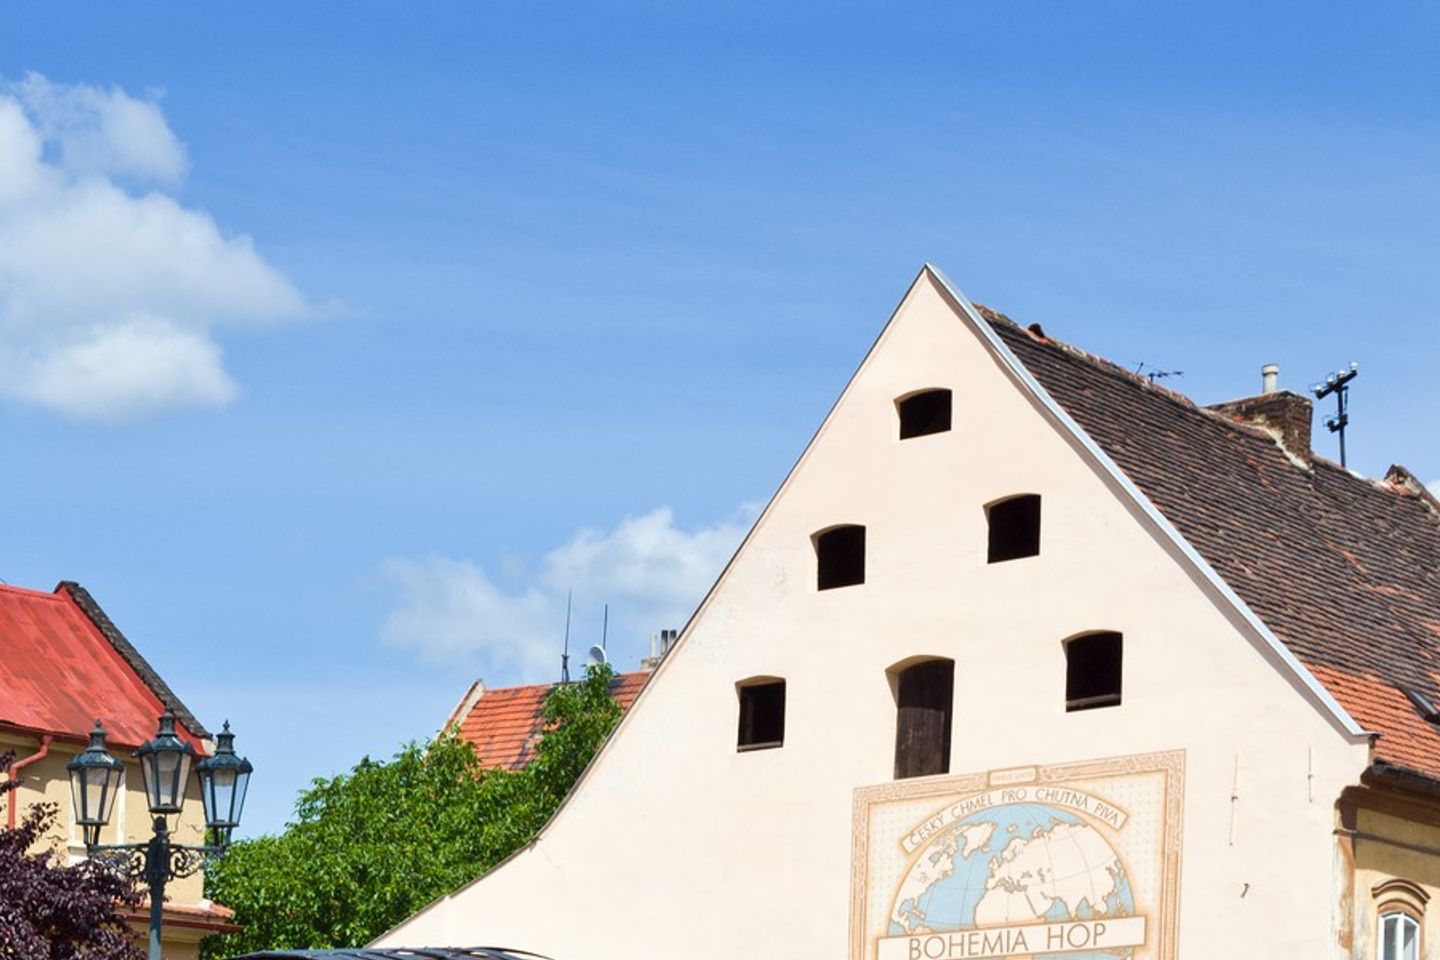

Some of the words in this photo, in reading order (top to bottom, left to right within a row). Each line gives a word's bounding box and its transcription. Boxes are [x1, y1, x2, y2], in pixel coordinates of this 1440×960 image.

[1001, 788, 1027, 803] PRO
[1094, 802, 1120, 826] PIVA
[909, 929, 1029, 960] BOHEMIA
[1047, 923, 1106, 950] HOP
